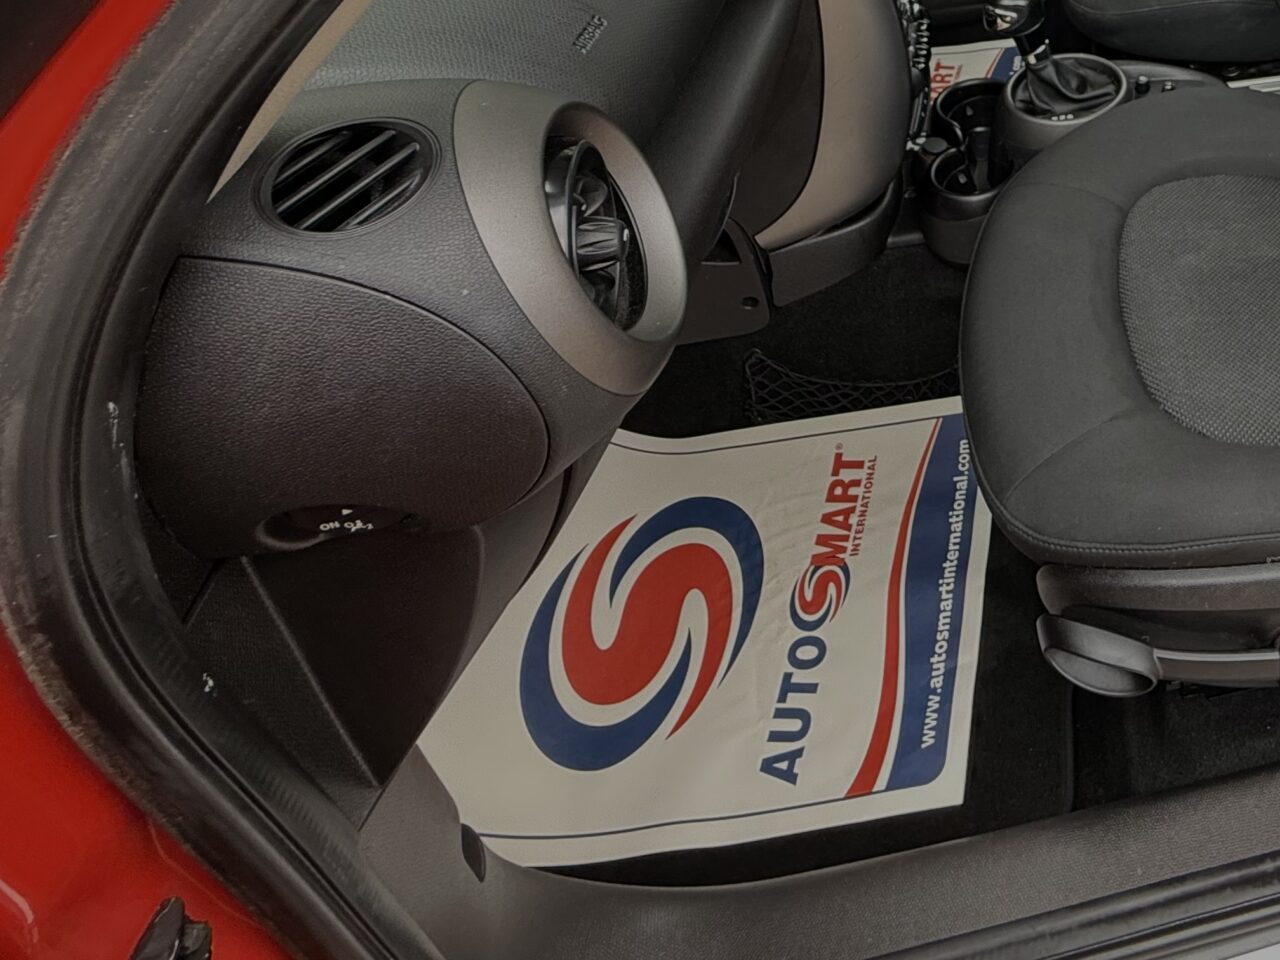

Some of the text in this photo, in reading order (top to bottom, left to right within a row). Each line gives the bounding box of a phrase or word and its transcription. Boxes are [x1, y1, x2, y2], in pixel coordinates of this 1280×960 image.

[572, 15, 608, 54] AIRBAG
[848, 455, 878, 557] INTERNATIONAL
[920, 438, 971, 750] www.autosmartinternational.com
